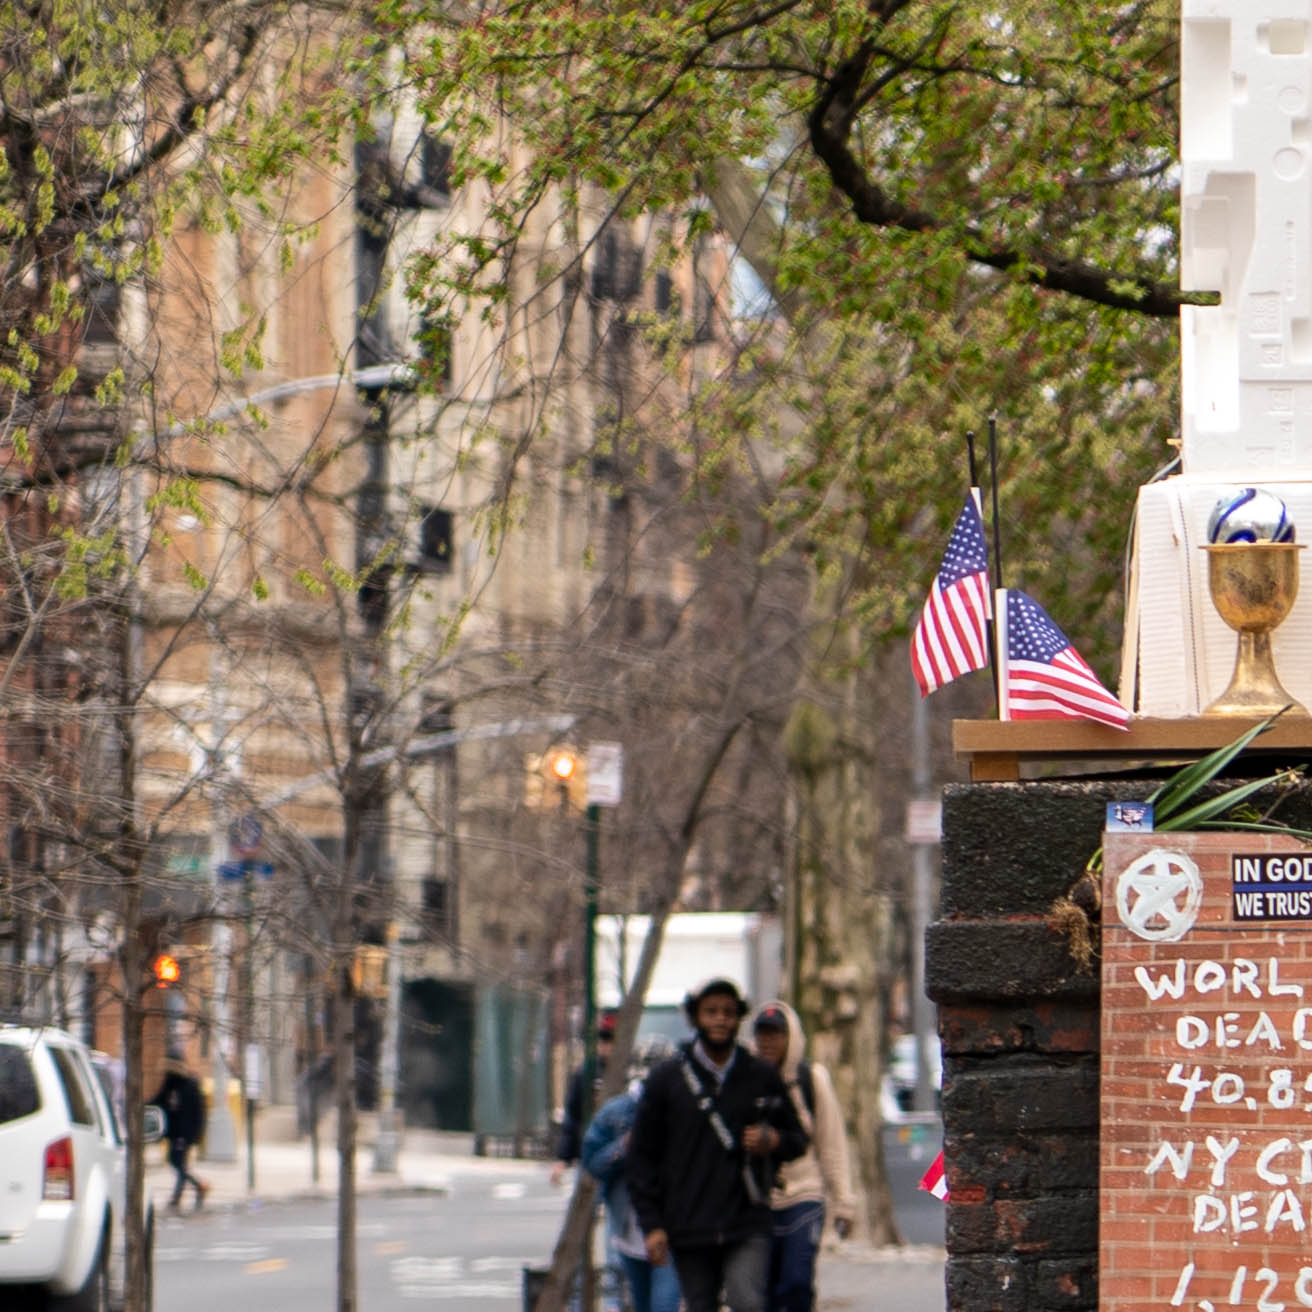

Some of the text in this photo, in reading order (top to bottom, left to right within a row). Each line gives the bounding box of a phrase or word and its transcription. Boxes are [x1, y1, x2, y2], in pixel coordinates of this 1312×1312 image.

[1234, 858, 1261, 882] IN
[1235, 892, 1264, 917] WE
[1144, 1136, 1239, 1187] NY
